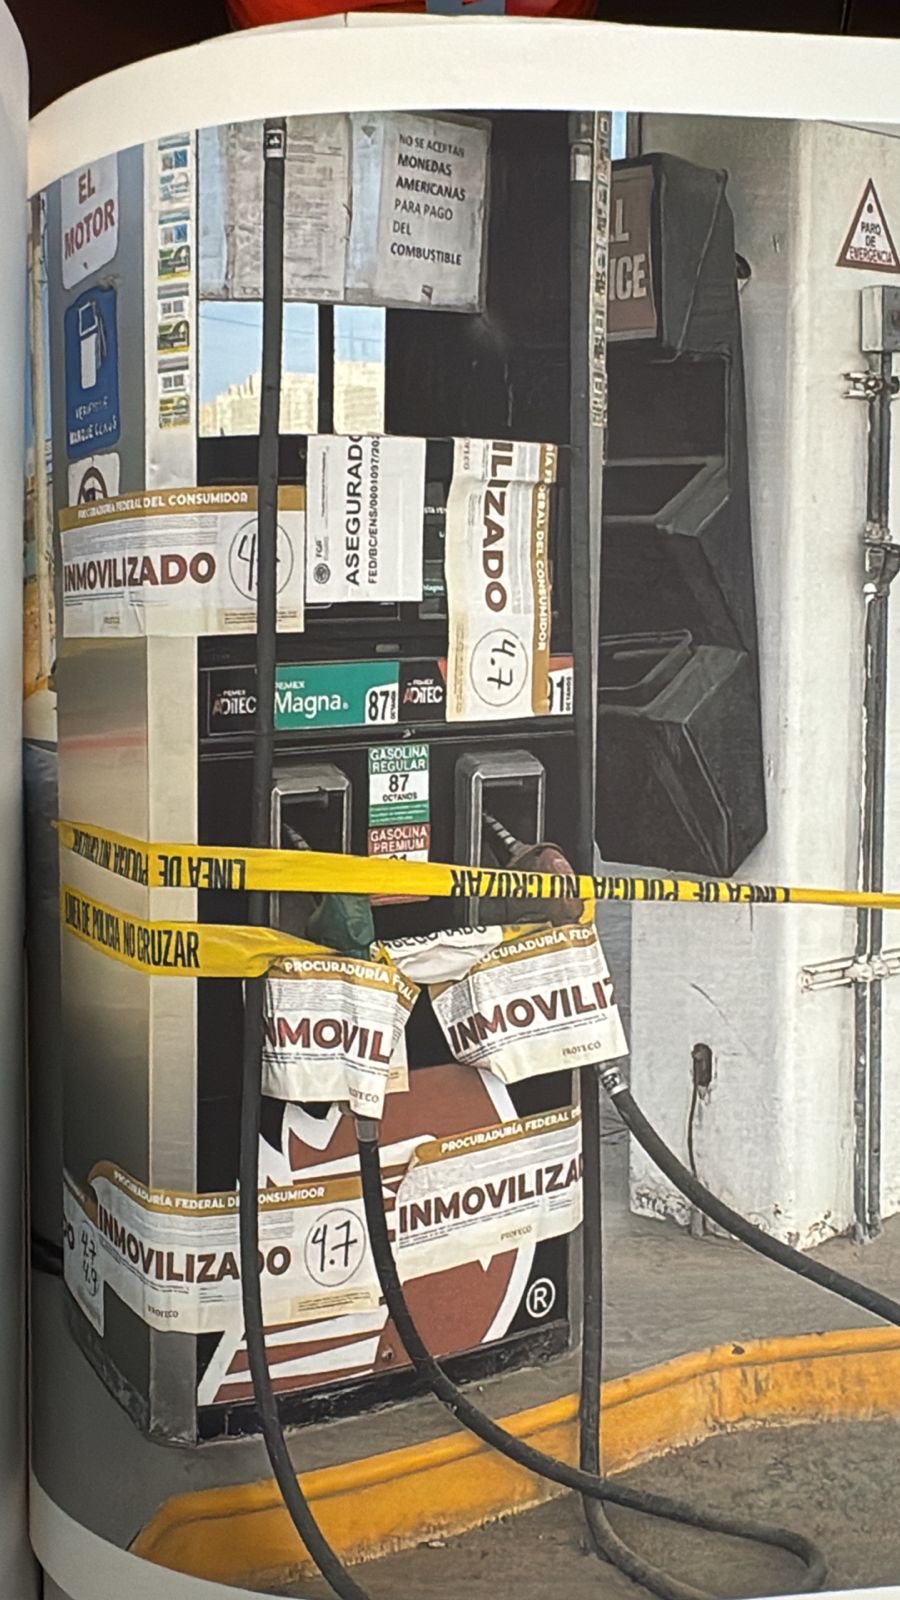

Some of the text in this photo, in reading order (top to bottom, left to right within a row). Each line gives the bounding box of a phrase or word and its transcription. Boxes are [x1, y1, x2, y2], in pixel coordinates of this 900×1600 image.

[399, 134, 413, 147] NO
[415, 136, 425, 149] SE
[397, 153, 452, 177] MONEDAS
[78, 167, 96, 204] EL
[395, 175, 466, 202] AMERICANAS
[394, 197, 454, 221] PARA PAGO
[64, 198, 115, 260] MOTOR
[392, 220, 412, 236] DEL
[860, 221, 882, 236] PARO
[865, 235, 876, 247] DE
[390, 241, 462, 266] COMBUSTIBLE
[143, 495, 165, 509] DEL
[168, 491, 248, 507] CONSUMIDOR
[64, 551, 216, 593] INMOVILIZADO
[535, 560, 549, 651] CONSUMIDOR
[487, 638, 517, 690] 4.7
[368, 690, 389, 721] 87
[370, 747, 427, 760] GASOLINA
[372, 759, 425, 773] REGULAR
[388, 774, 409, 793] 87
[382, 791, 418, 802] OCTANOS
[370, 826, 427, 842] GASOLINA
[373, 838, 424, 853] PREMIUM
[158, 855, 182, 887] DE
[188, 856, 246, 890] LINEA
[450, 869, 543, 899] CRUZAR
[549, 873, 580, 899] NO
[123, 920, 135, 959] NO
[138, 925, 200, 969] CRUZAR
[285, 960, 390, 984] PROCURADURÍA
[441, 1122, 523, 1154] PROCURADURÍA
[525, 1111, 569, 1132] FEDERAL
[175, 1197, 225, 1210] FEDERAL
[258, 1187, 325, 1204] ONSUMIDOR
[311, 1220, 358, 1273] 4.7
